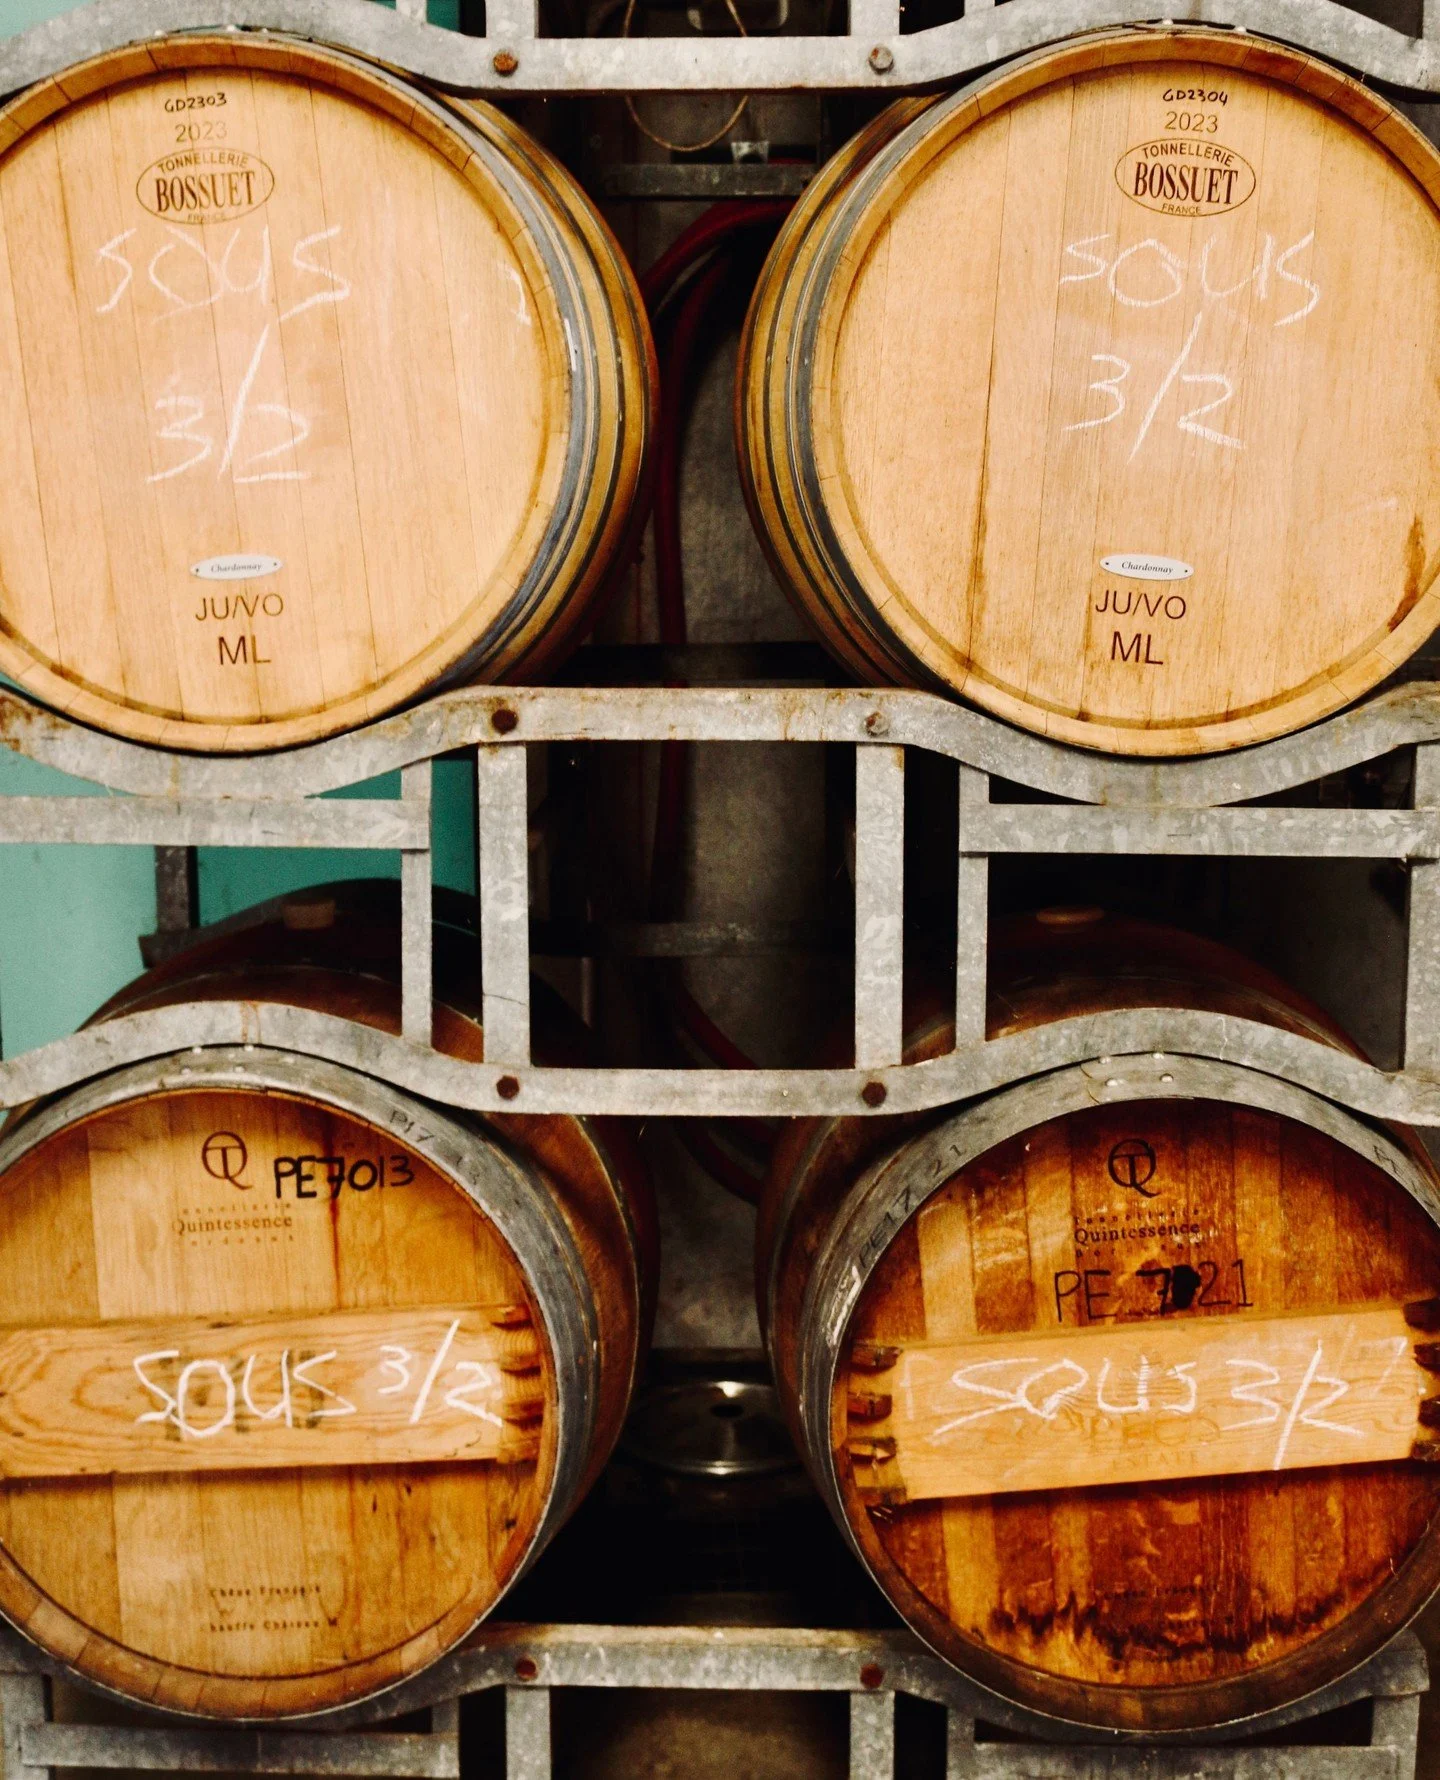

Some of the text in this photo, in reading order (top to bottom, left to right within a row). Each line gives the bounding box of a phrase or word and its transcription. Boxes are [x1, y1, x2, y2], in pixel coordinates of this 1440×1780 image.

[164, 91, 228, 113] GD2303
[1162, 88, 1229, 107] GD2304
[175, 120, 228, 142] 2023
[1164, 110, 1220, 134] 2023
[156, 151, 250, 174] TONNELLERIE
[1142, 142, 1235, 167] TONNELLERIE
[154, 170, 256, 213] BOSSUET
[1133, 160, 1239, 205] BOSSUET
[1161, 202, 1202, 216] FRANCE
[1060, 311, 1248, 465] 3/2
[210, 563, 263, 574] Chardonnay
[1120, 560, 1174, 575] Chardonnay
[1095, 589, 1187, 620] JU/VO
[217, 635, 272, 666] ML
[1110, 630, 1164, 666] ML
[273, 1154, 415, 1199] PE7013
[171, 1216, 293, 1236] Quintessence
[1073, 1223, 1201, 1246] Quintessence
[132, 1347, 358, 1439] SOUS
[376, 1318, 504, 1429] 3/2
